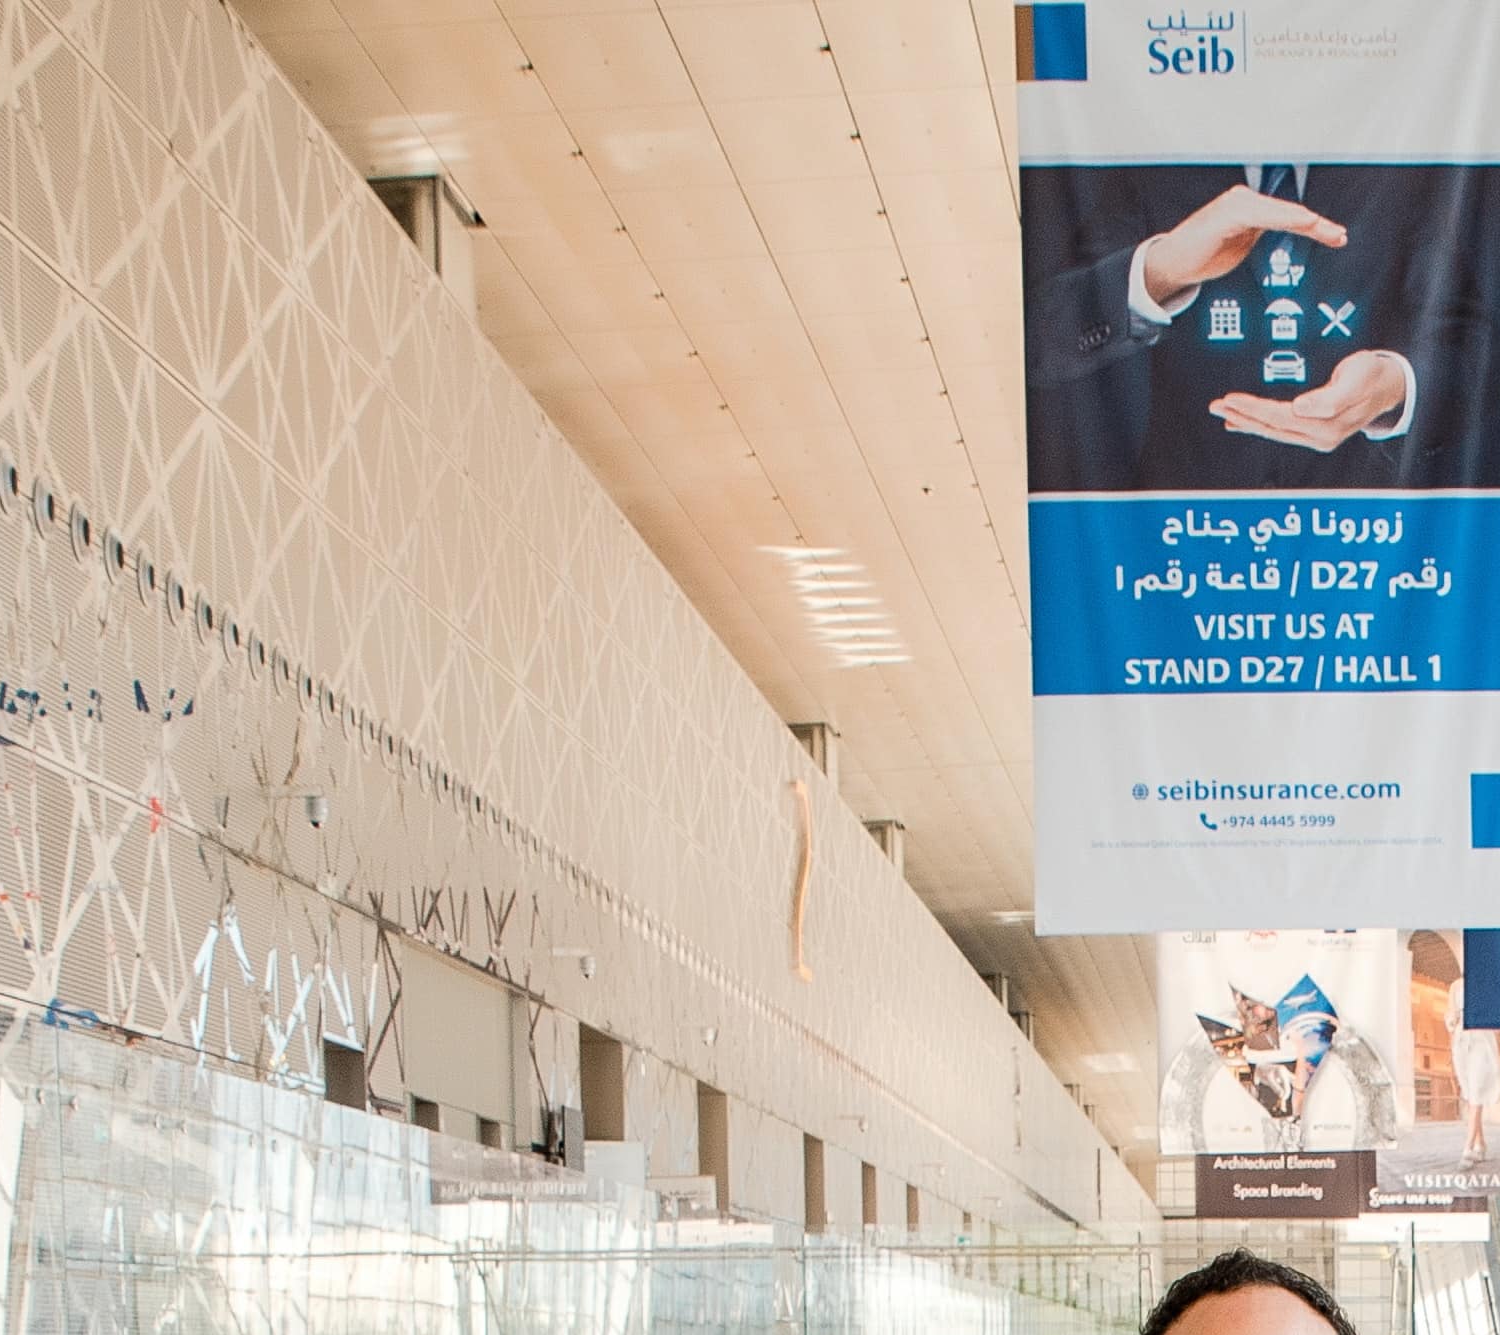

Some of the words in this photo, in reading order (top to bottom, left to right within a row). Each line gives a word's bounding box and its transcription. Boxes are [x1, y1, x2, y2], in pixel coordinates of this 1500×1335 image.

[1149, 35, 1234, 74] Seib
[1161, 509, 1240, 545] جناح
[1249, 505, 1301, 553] في
[1311, 508, 1404, 543] زورونا
[1134, 559, 1198, 600] رقم
[1205, 558, 1280, 590] قاعة
[1310, 561, 1379, 589] D27
[1388, 557, 1452, 598] رقم
[1194, 614, 1276, 640] VISIT
[1285, 614, 1326, 640] US
[1335, 613, 1374, 639] AT
[1124, 658, 1230, 684] STAND
[1240, 656, 1304, 682] D27
[1315, 655, 1325, 690] /
[1334, 656, 1417, 682] HALL
[1428, 655, 1442, 681] 1
[1157, 780, 1400, 801] seibinsurance.com
[1259, 814, 1295, 828] 4445
[1299, 814, 1336, 828] 5999
[1213, 1155, 1285, 1170] Architectural
[1287, 1155, 1337, 1170] Elements
[1233, 1184, 1268, 1200] Space
[1271, 1182, 1323, 1200] Branding
